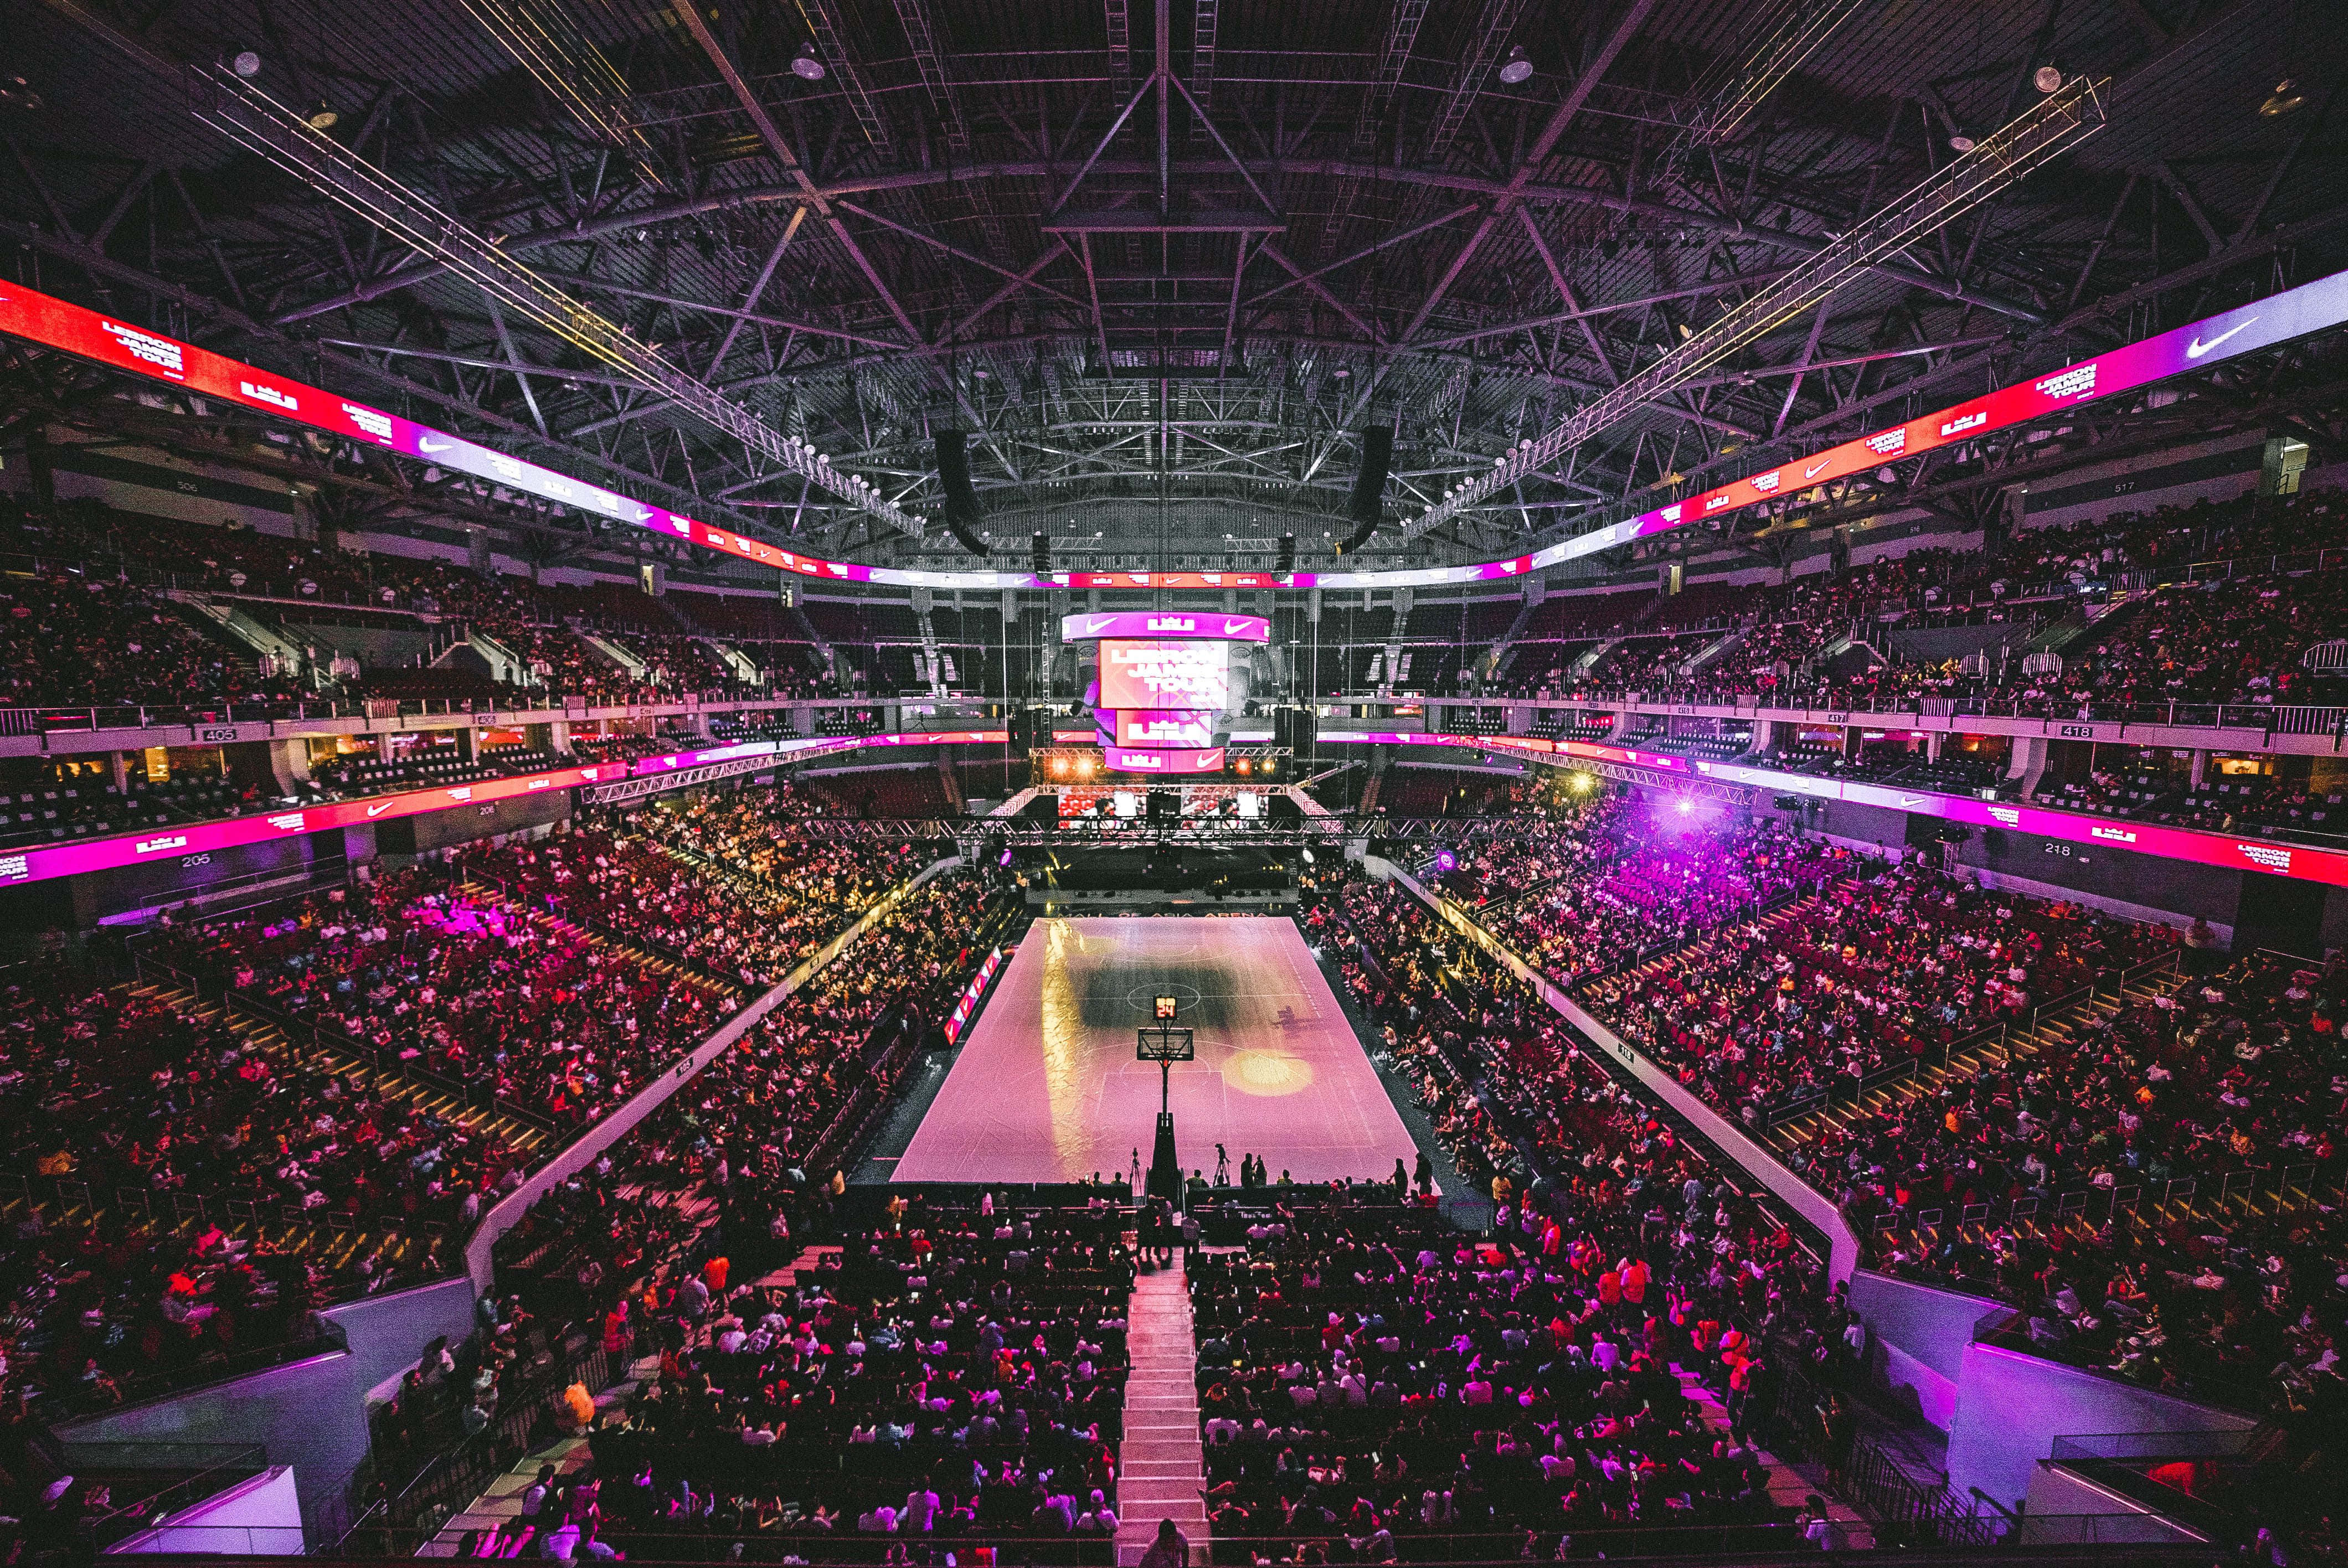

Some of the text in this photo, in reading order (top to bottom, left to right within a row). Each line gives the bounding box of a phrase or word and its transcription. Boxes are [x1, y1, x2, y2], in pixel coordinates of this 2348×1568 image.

[102, 321, 181, 355] LEBRON
[116, 337, 182, 363] JAMES
[129, 347, 183, 371] TOUR
[2036, 363, 2097, 390] LEBRON
[2044, 372, 2096, 394] JAMES
[2052, 380, 2095, 399] TOUR
[1866, 428, 1905, 446] LEBRON
[1877, 440, 1904, 453] TOUR
[2115, 482, 2134, 492] 517
[1111, 649, 1218, 663] LEBRON
[1127, 664, 1218, 678] JAMES
[1144, 678, 1218, 692] TOUR
[207, 730, 234, 740] 405
[2064, 727, 2090, 737] 418
[2045, 843, 2070, 856] 218
[2238, 844, 2291, 857] LEBRON
[182, 853, 210, 867] 205
[2245, 852, 2290, 862] JAMES
[2252, 857, 2289, 868] TOUR
[0, 866, 28, 876] OUR
[1157, 1005, 1173, 1017] 24
[1621, 1047, 1631, 1060] 118
